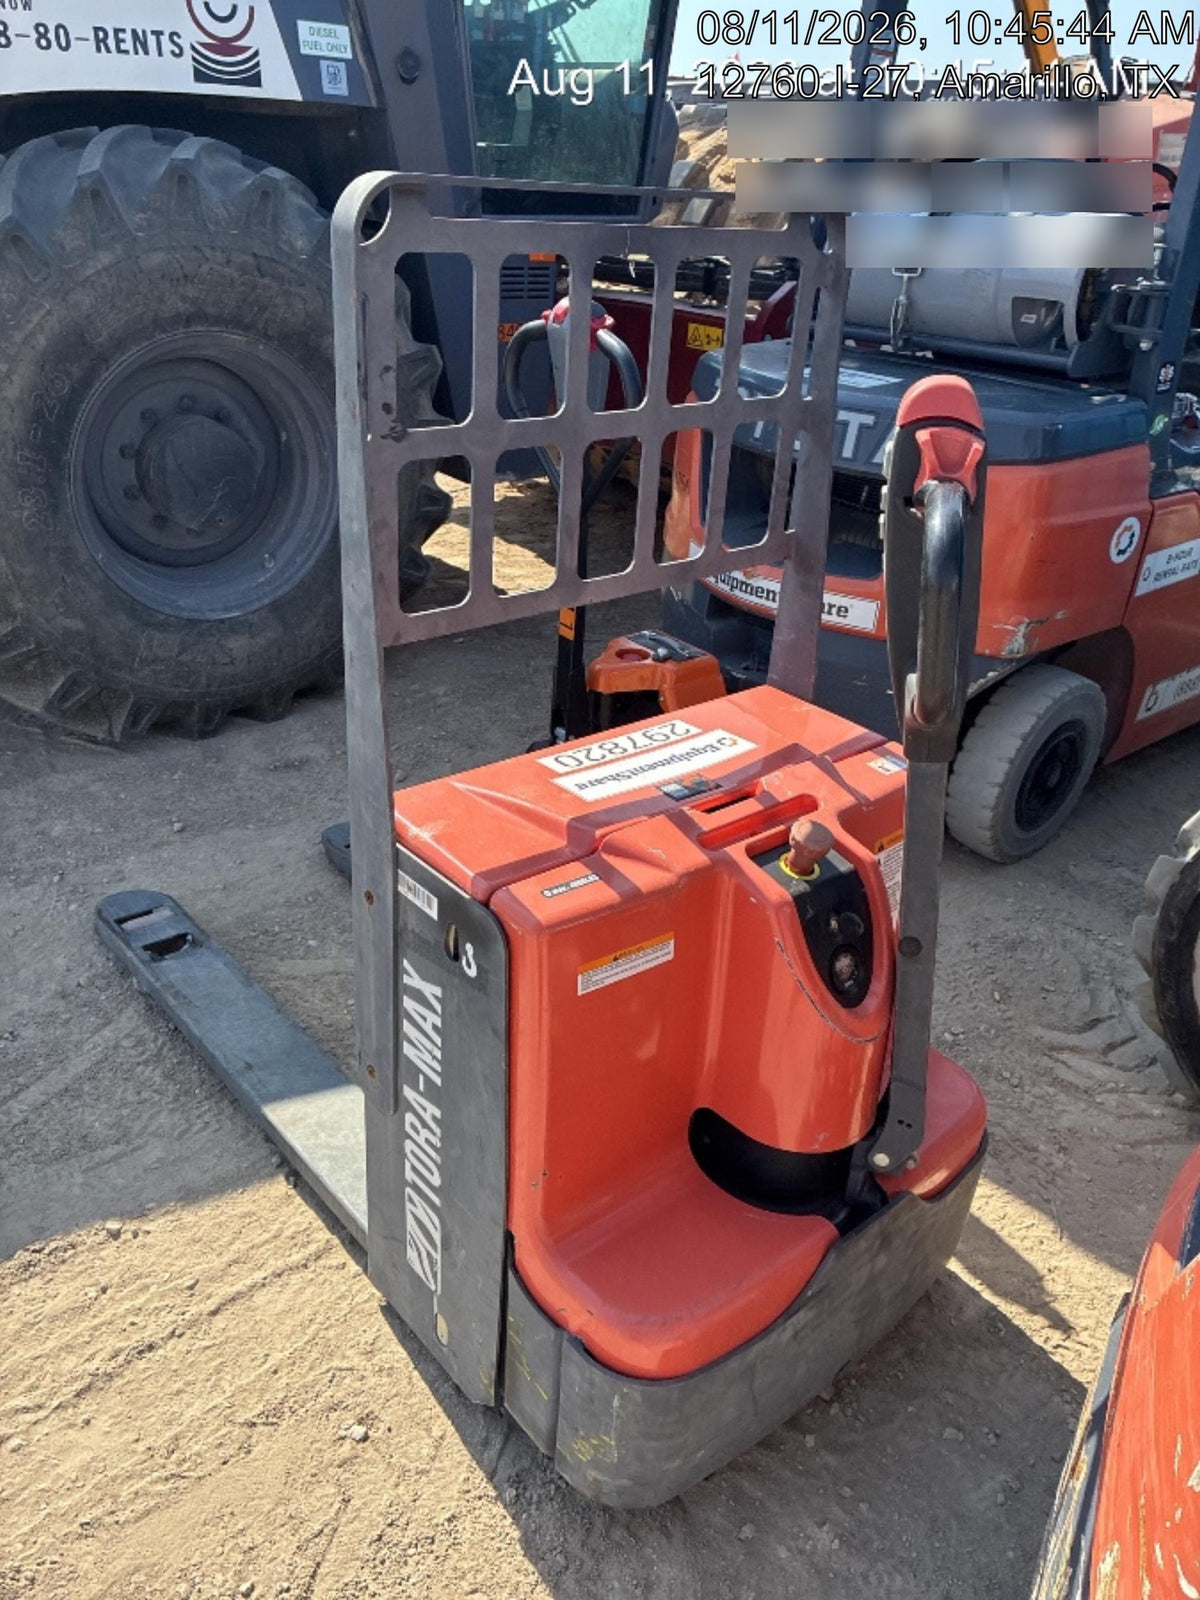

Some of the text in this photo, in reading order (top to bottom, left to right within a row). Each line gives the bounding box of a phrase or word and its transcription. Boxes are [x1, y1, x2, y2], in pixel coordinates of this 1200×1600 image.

[554, 722, 690, 768] 297820
[575, 743, 721, 790] EquipmentShare
[403, 958, 442, 1207] TORA-MAX
